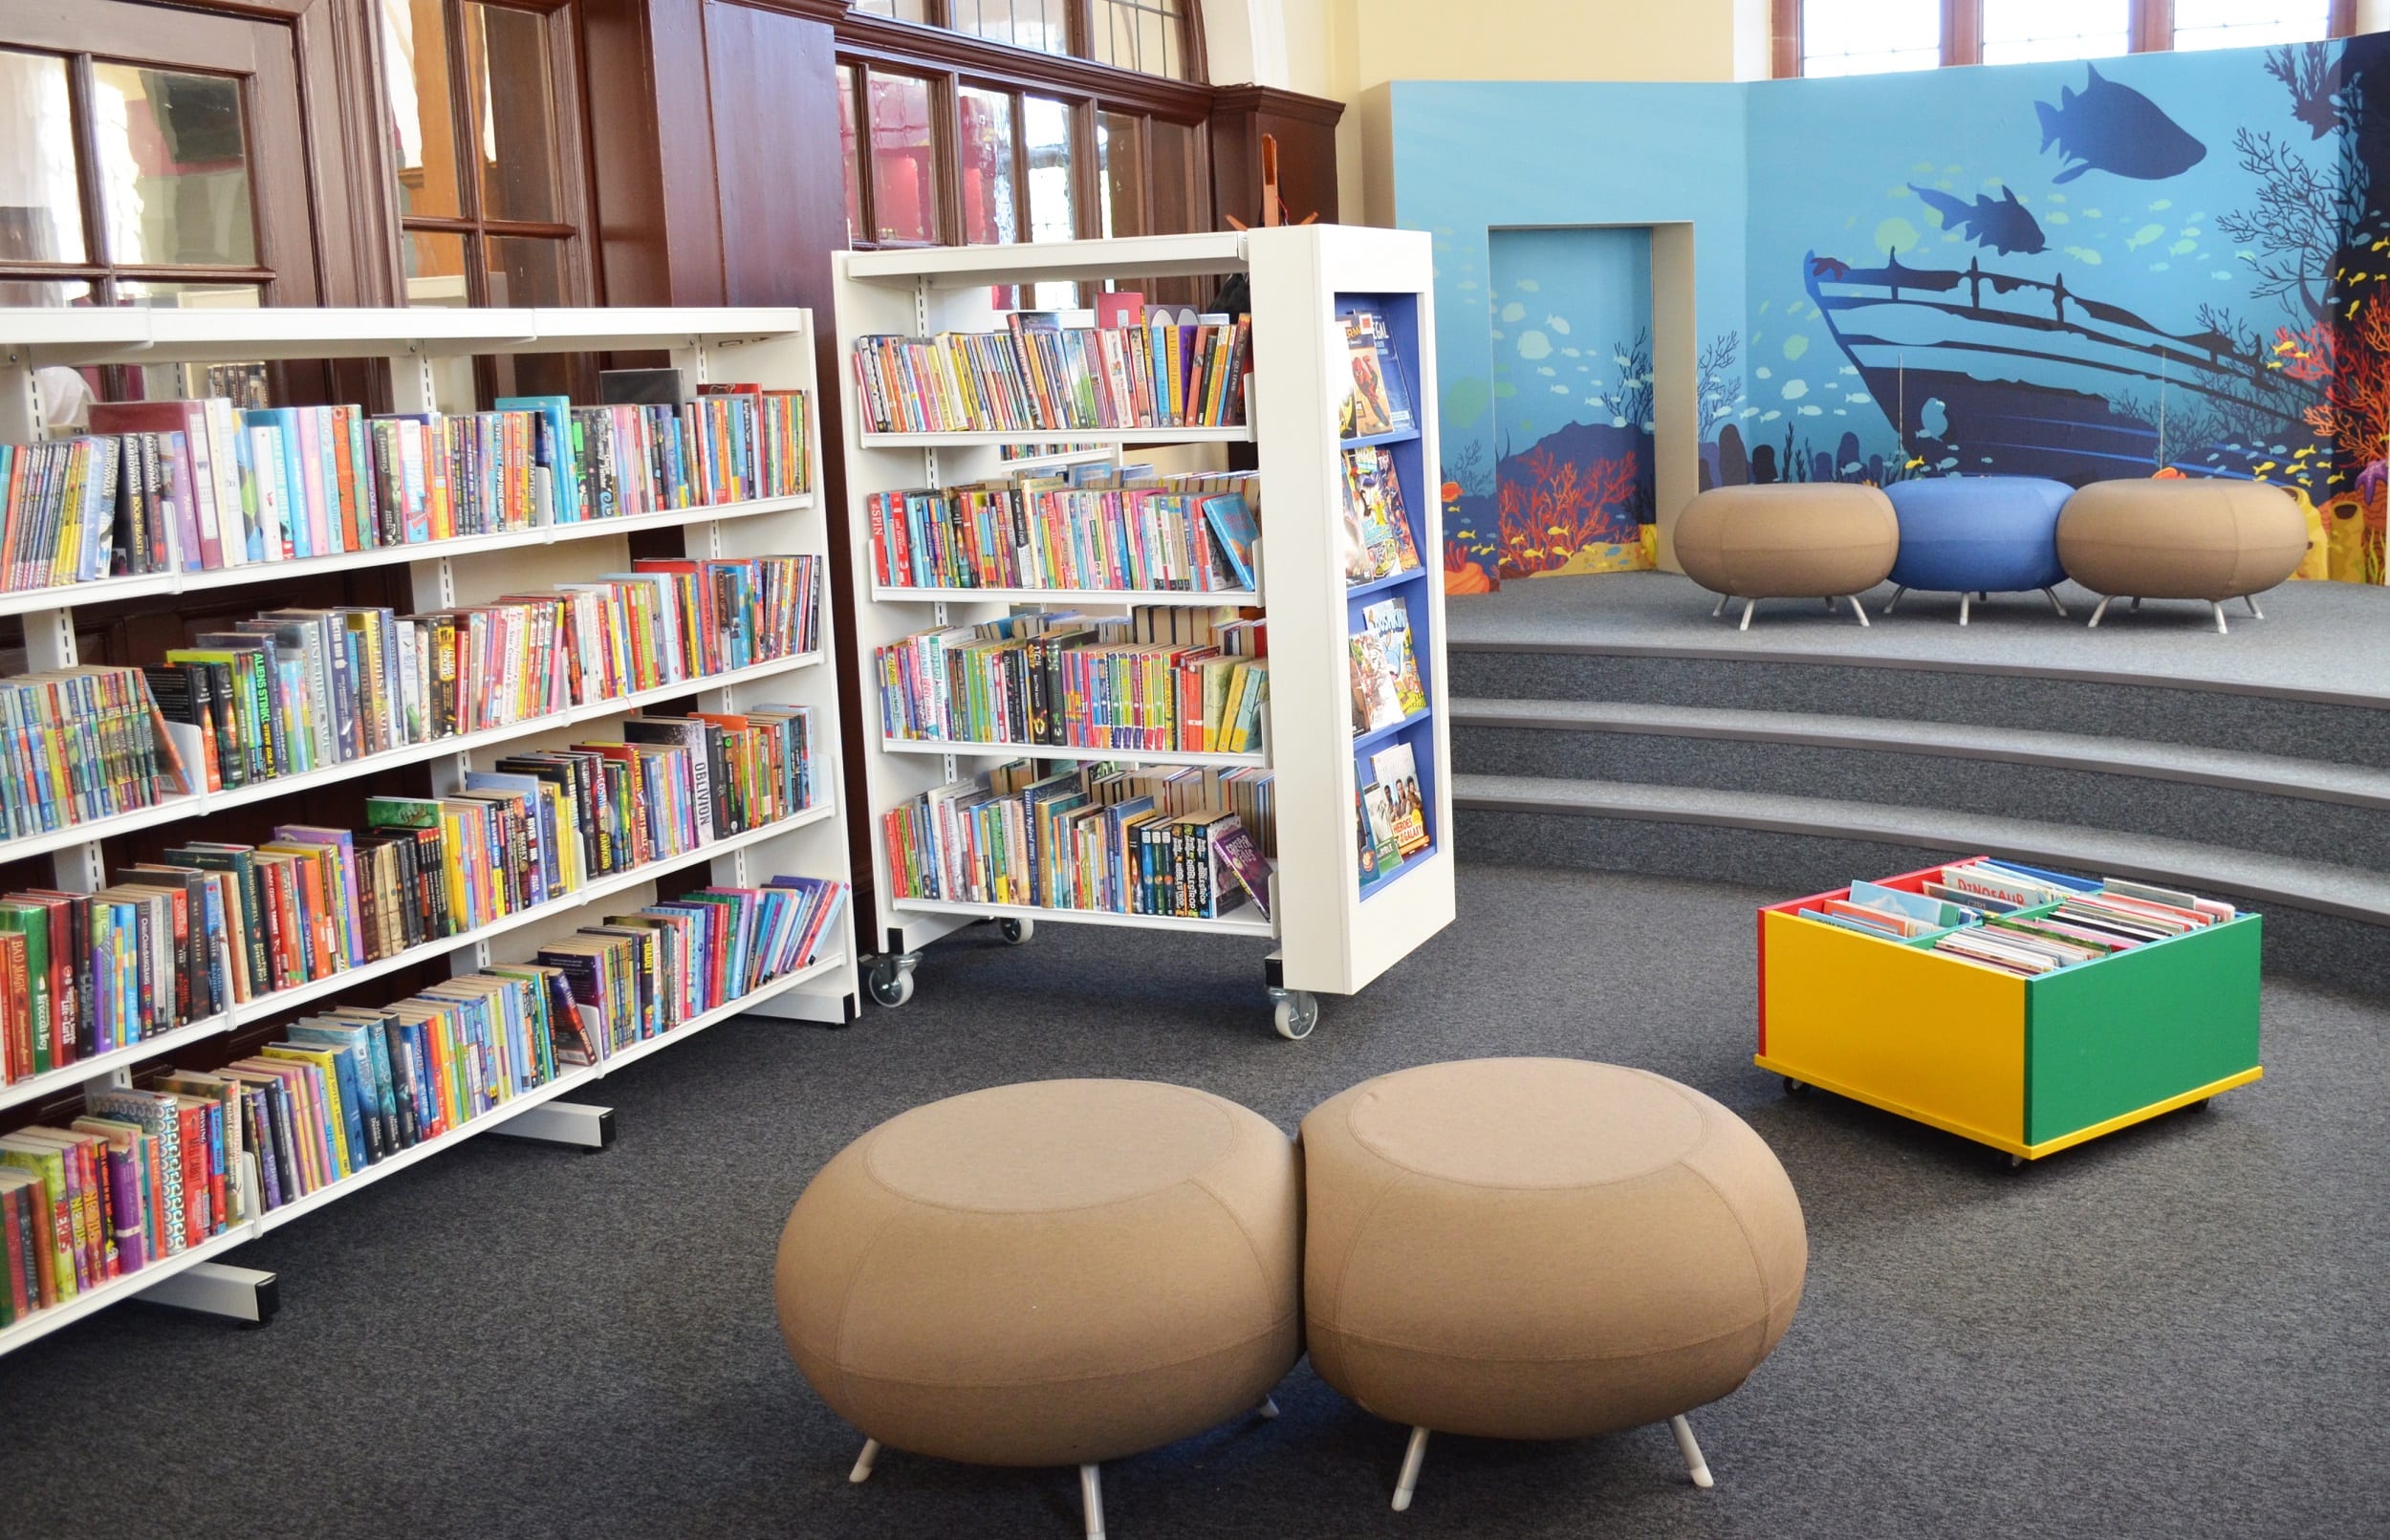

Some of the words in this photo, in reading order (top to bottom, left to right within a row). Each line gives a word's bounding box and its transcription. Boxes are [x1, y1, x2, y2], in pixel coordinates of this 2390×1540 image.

[103, 440, 113, 496] BARROWMAN
[145, 436, 156, 492] BARROWMAN
[126, 438, 137, 494] BARROWMAN
[133, 496, 141, 521] BOOK
[872, 510, 882, 535] SPIN
[253, 653, 266, 689] ALIENS
[258, 690, 270, 722] STINK!
[263, 724, 272, 746] STEVE
[694, 762, 710, 826] OBLIVION
[527, 817, 536, 839] RIVER
[1393, 817, 1413, 834] HEROES
[1403, 825, 1423, 843] GALAXY
[599, 834, 609, 869] HAWKING
[1187, 859, 1196, 908] RIBBLESTROP
[11, 940, 24, 963] BAD
[12, 964, 26, 993] MAGIC
[37, 994, 49, 1032] Broccoli
[61, 1000, 70, 1016] Life
[38, 1034, 50, 1051] Boy
[62, 1021, 71, 1044] Earth
[55, 1202, 73, 1254] NERDS
